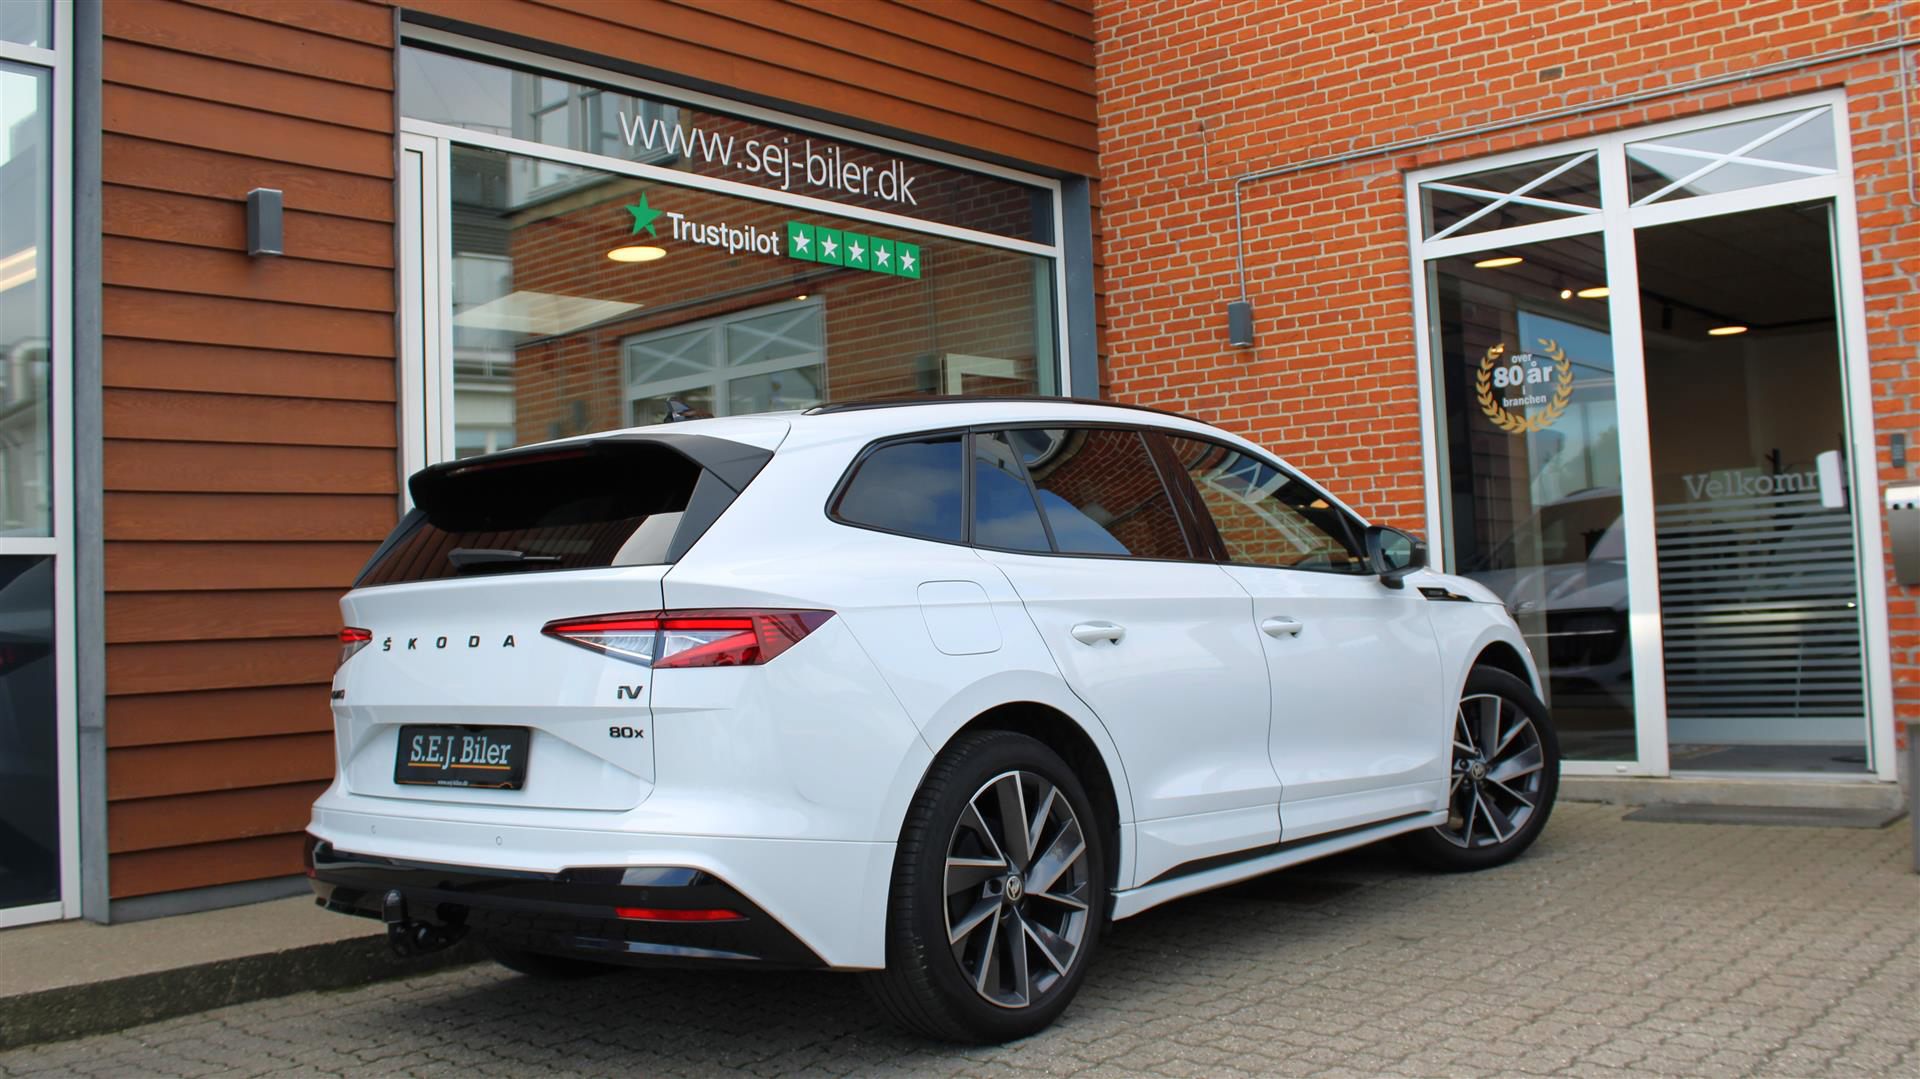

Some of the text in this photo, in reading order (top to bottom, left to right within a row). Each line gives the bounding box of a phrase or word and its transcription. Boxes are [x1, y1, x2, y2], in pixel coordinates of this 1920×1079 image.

[619, 112, 918, 205] www.sej-biler.dk
[667, 212, 780, 256] Trustpilot
[1511, 353, 1532, 364] over
[1493, 361, 1553, 388] 80 år
[1503, 394, 1547, 408] branchen
[410, 735, 511, 770] S.E.J. Biler
